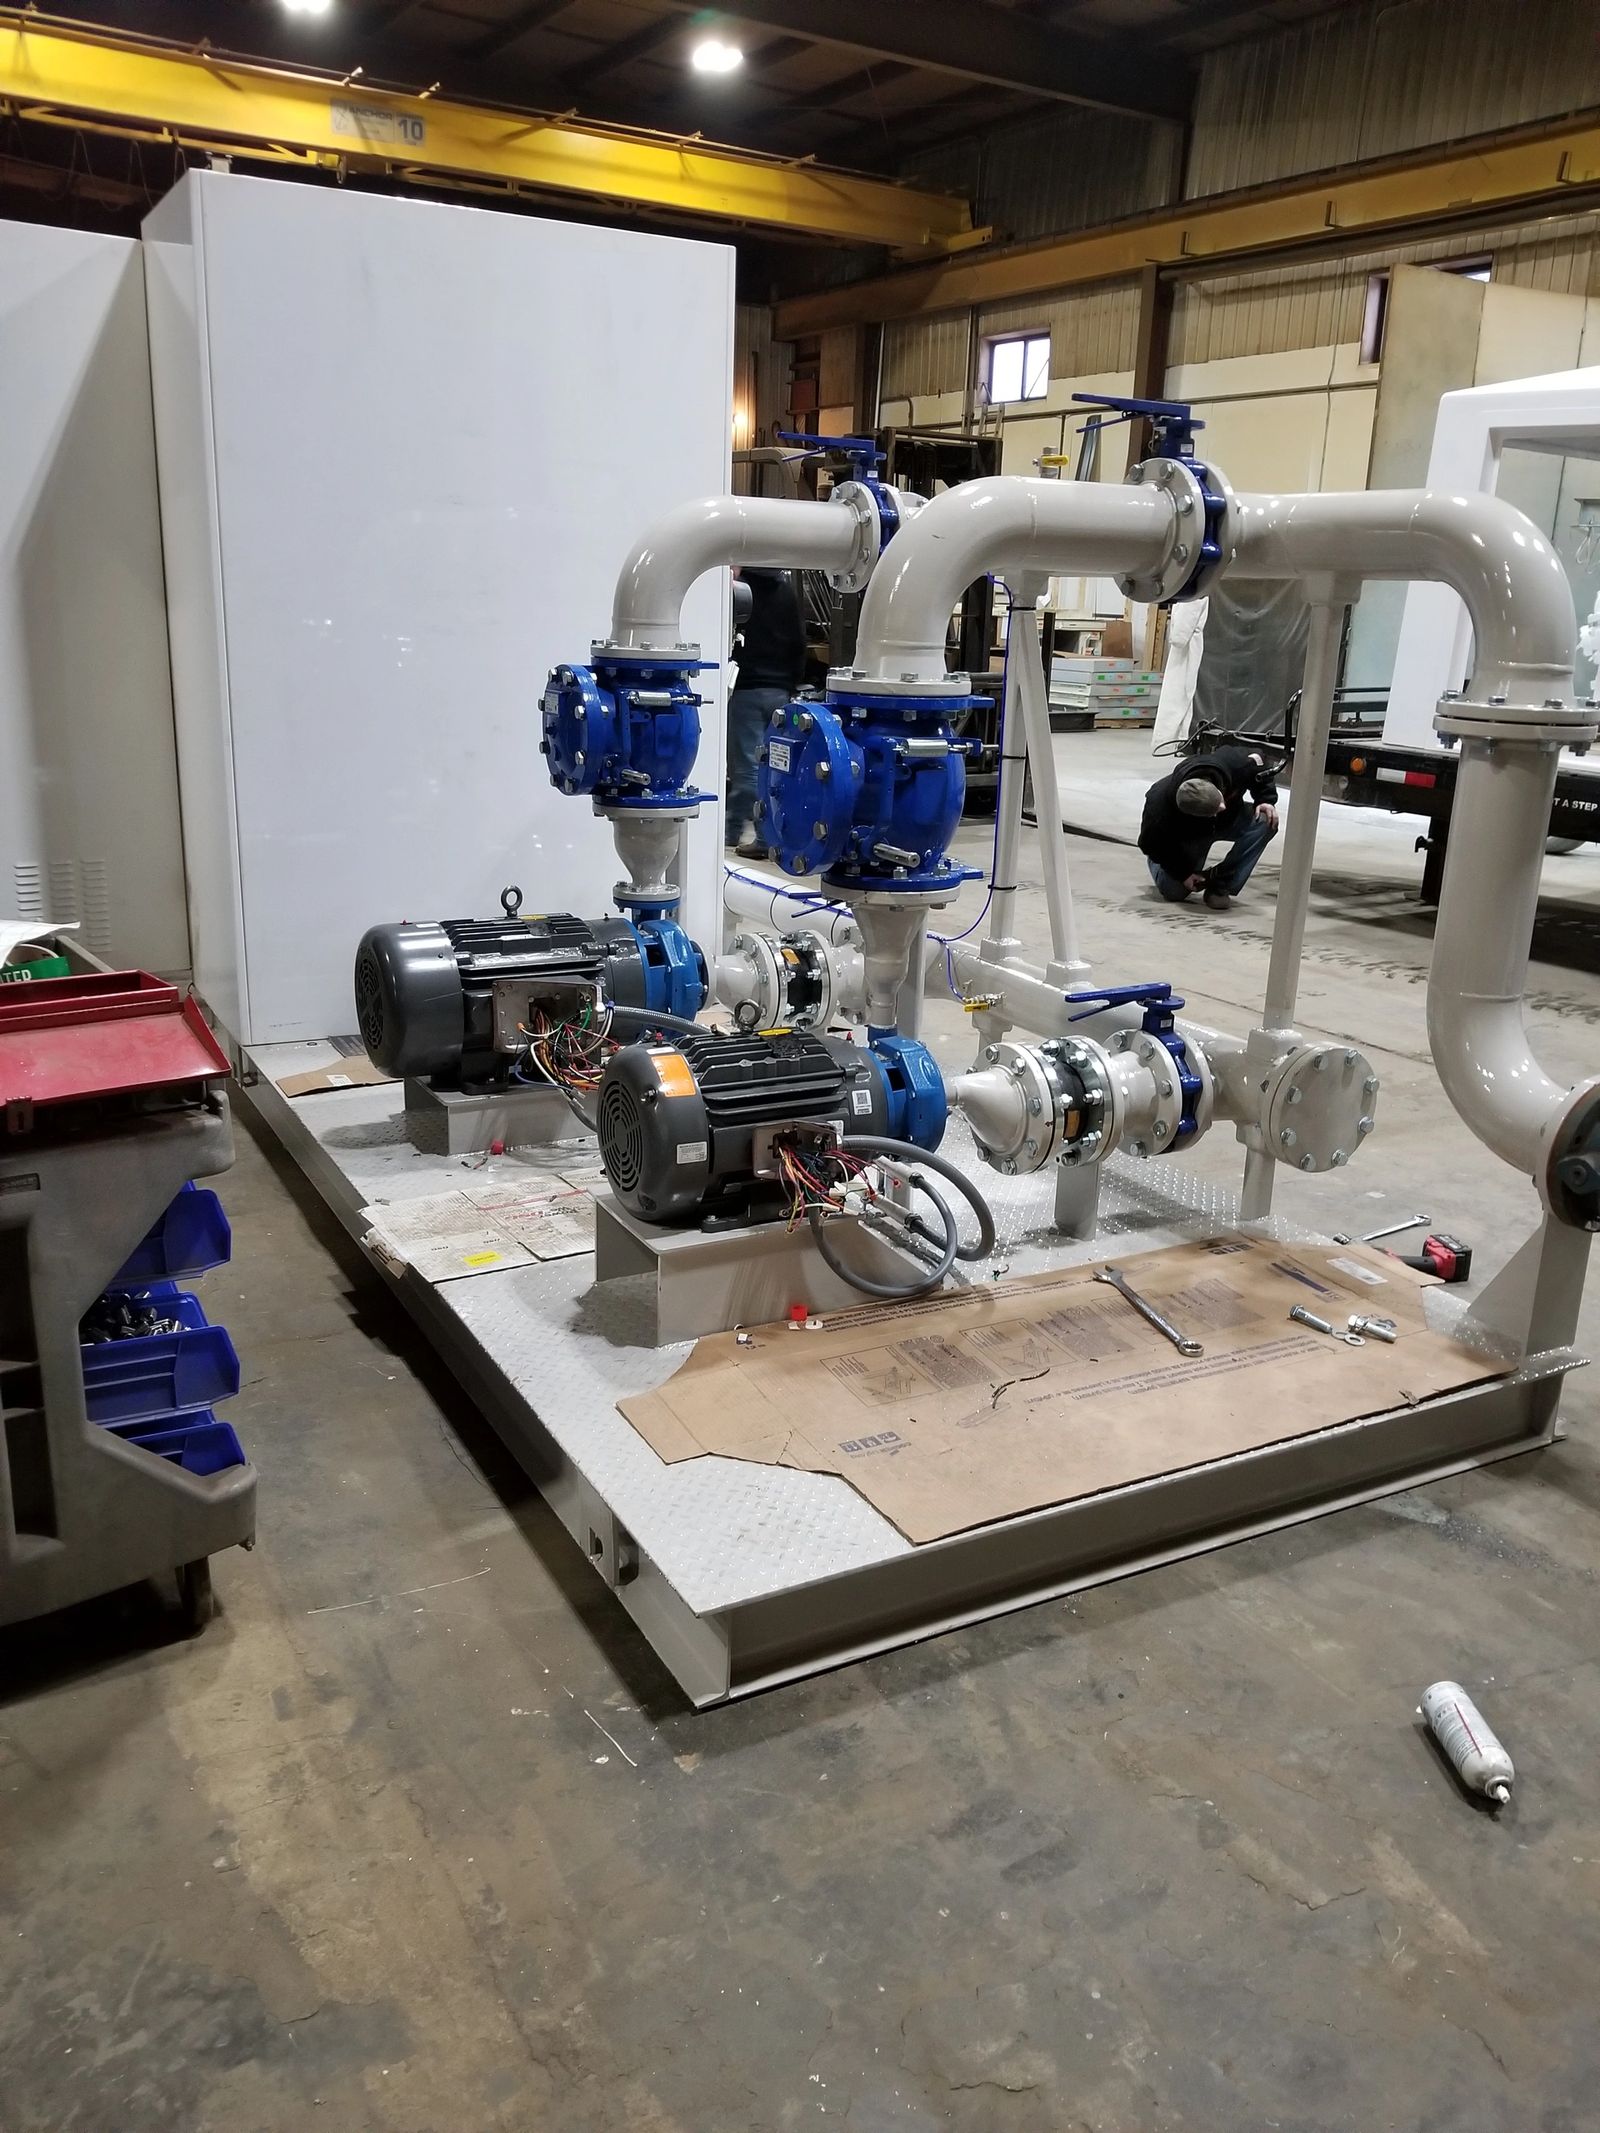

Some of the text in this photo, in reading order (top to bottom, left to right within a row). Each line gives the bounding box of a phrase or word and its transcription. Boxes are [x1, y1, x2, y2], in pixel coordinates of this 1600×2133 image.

[398, 119, 424, 141] 10
[1562, 799, 1569, 808] A
[1572, 800, 1598, 811] STEP
